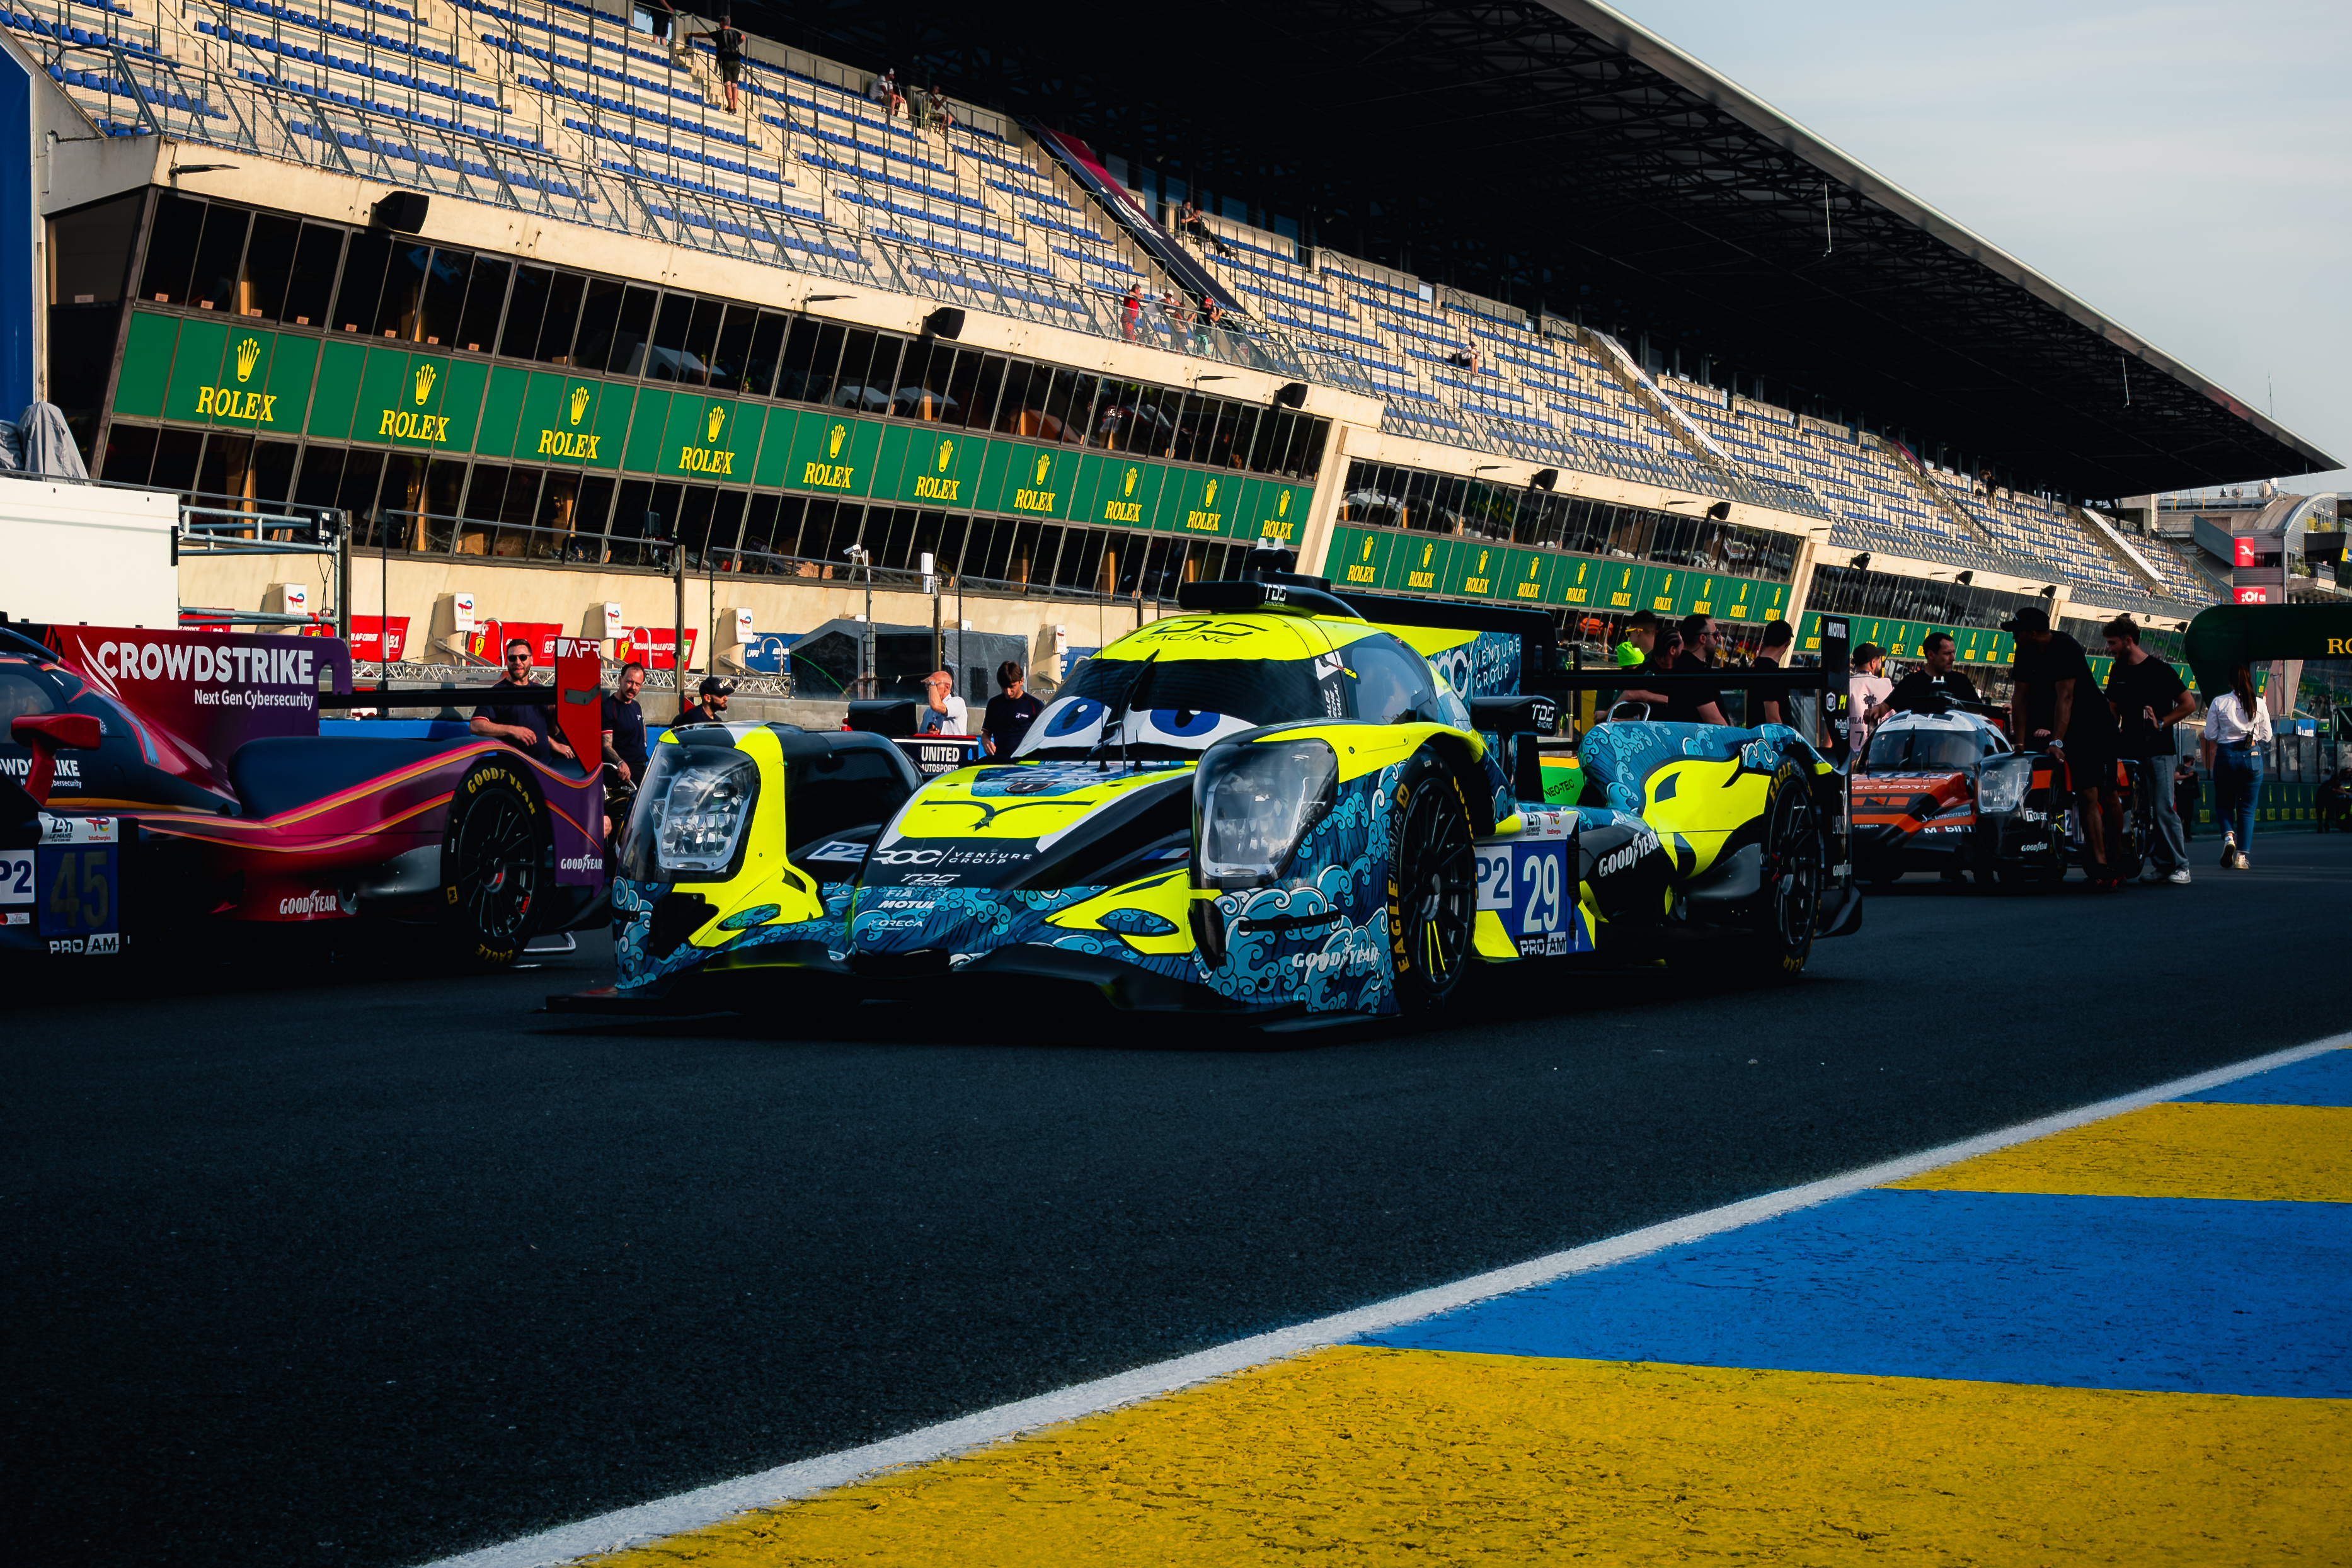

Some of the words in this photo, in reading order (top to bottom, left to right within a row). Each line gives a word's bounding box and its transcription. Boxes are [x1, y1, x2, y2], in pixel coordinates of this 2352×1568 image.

[196, 386, 277, 424] ROLEX
[379, 409, 450, 444] ROLEX
[537, 429, 600, 461] ROLEX
[679, 446, 735, 476] ROLEX
[803, 461, 854, 489] ROLEX
[914, 476, 960, 501] ROLEX
[1014, 488, 1055, 513] ROLEX
[1104, 500, 1142, 523] ROLEX
[1186, 511, 1221, 531] ROLEX
[1261, 519, 1294, 540] ROLEX
[1347, 564, 1375, 583] ROLEX
[1408, 571, 1435, 588] ROLEX
[1465, 577, 1489, 594] ROLEX
[1517, 583, 1540, 598] ROLEX
[1566, 588, 1587, 603] ROLEX
[1611, 592, 1631, 607] ROLEX
[1828, 621, 1846, 639] MOTUL
[98, 641, 313, 685] CROWDSTRIKE
[1476, 663, 1509, 689] GROUP
[194, 689, 219, 706] Next
[222, 690, 242, 706] Gen
[245, 690, 313, 711] Cybersecurity
[1532, 704, 1555, 722] TDS
[921, 746, 960, 762] UNITED
[921, 764, 959, 773] AUTOSPORTS
[561, 854, 603, 873] GOODYEAR
[955, 852, 1033, 860] VENTURE
[1598, 830, 1660, 878] GOODYEAR
[50, 851, 109, 928] 45
[1523, 854, 1559, 933] 29
[280, 889, 336, 918] GOODYEAR
[877, 900, 936, 909] MOTUL
[1387, 879, 1410, 973] EAGLE
[49, 939, 84, 954] PRO
[91, 937, 117, 953] AM
[1519, 938, 1545, 956] PRO
[1549, 936, 1566, 953] AM
[1292, 944, 1379, 970] GOODYEAR
